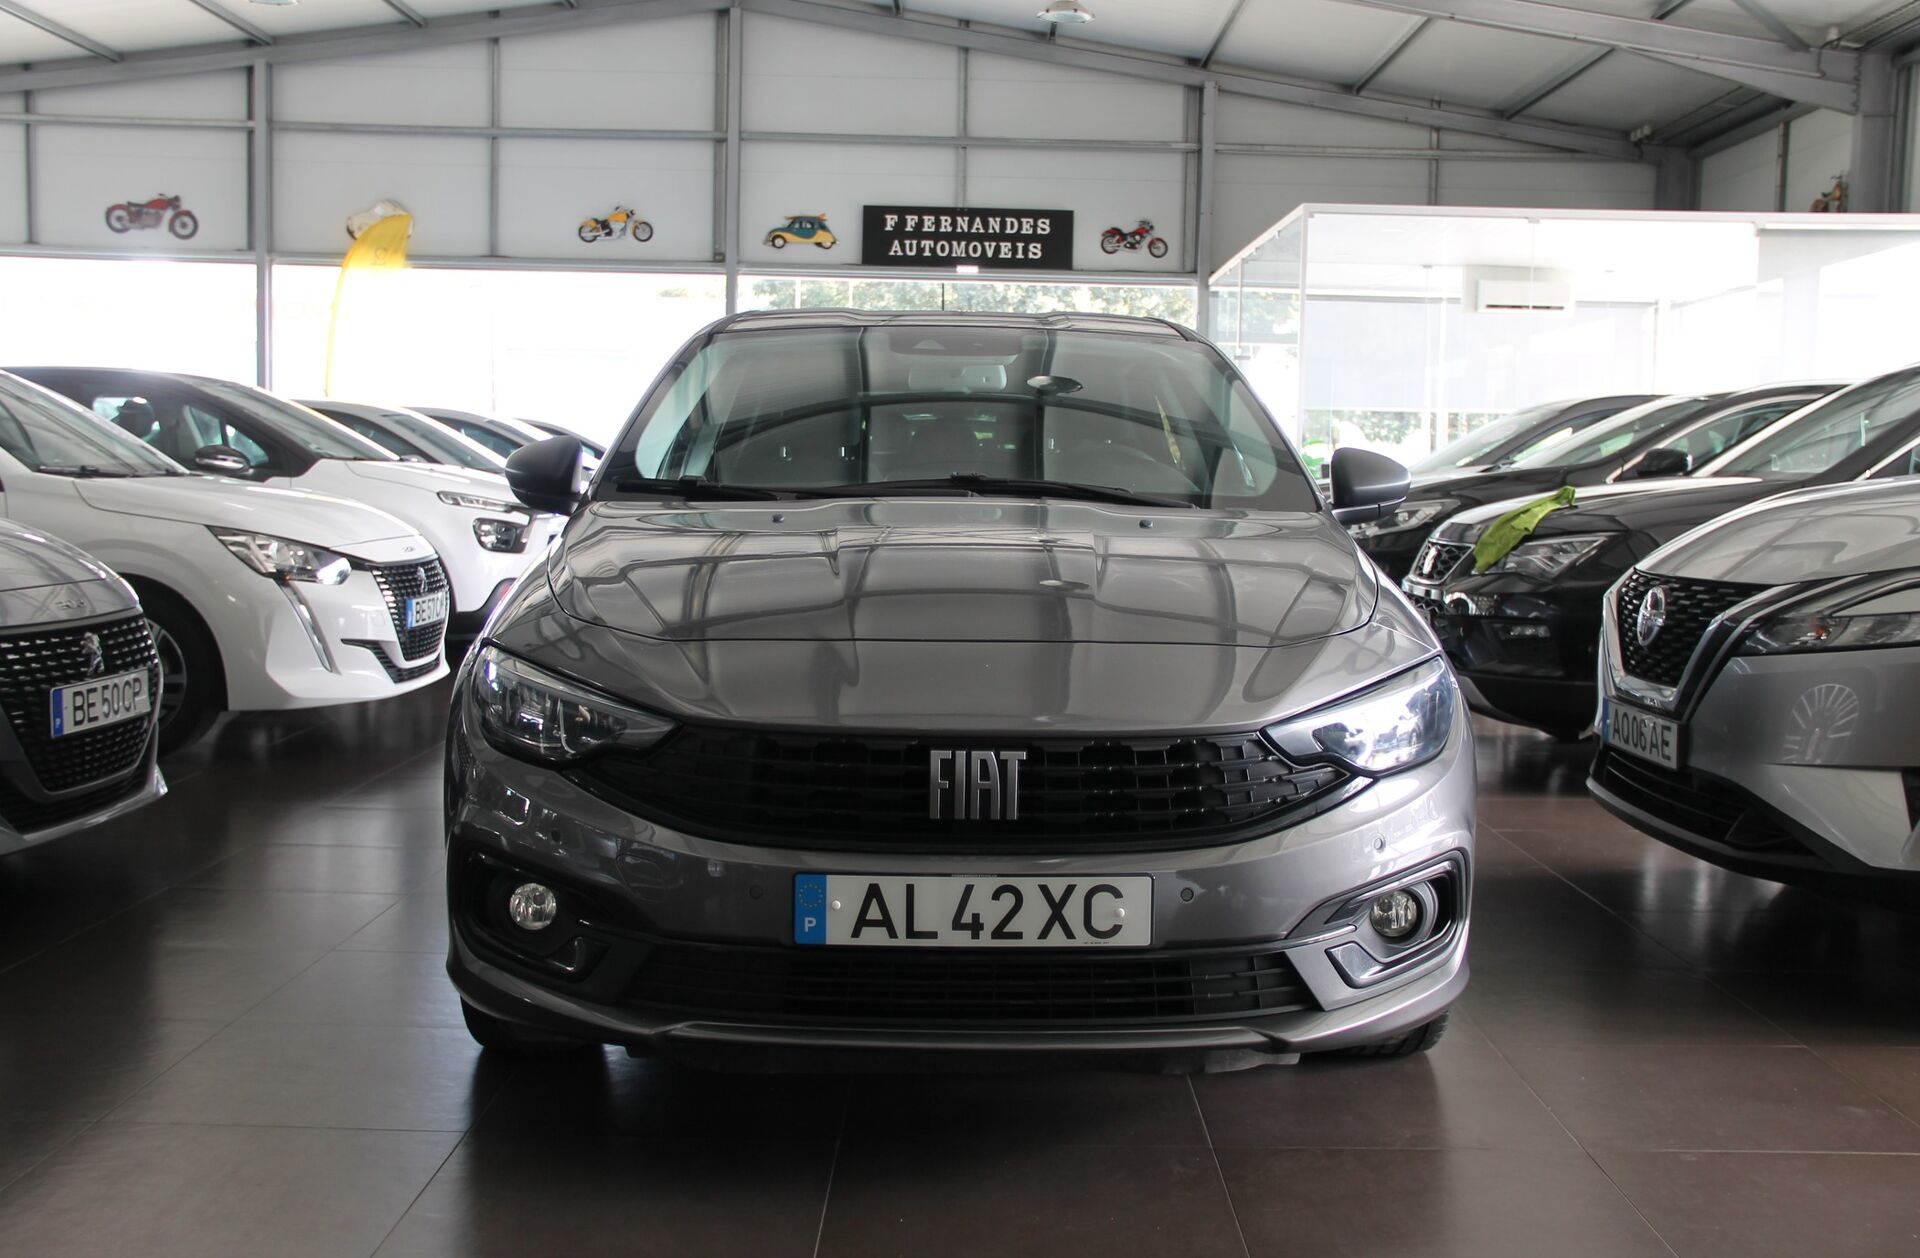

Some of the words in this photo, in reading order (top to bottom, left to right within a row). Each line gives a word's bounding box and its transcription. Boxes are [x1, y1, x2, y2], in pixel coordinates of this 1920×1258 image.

[905, 215, 1051, 235] FERNANDES
[888, 240, 1042, 259] AUTOMOVEIS
[929, 750, 1027, 820] FIAT
[804, 917, 817, 932] P
